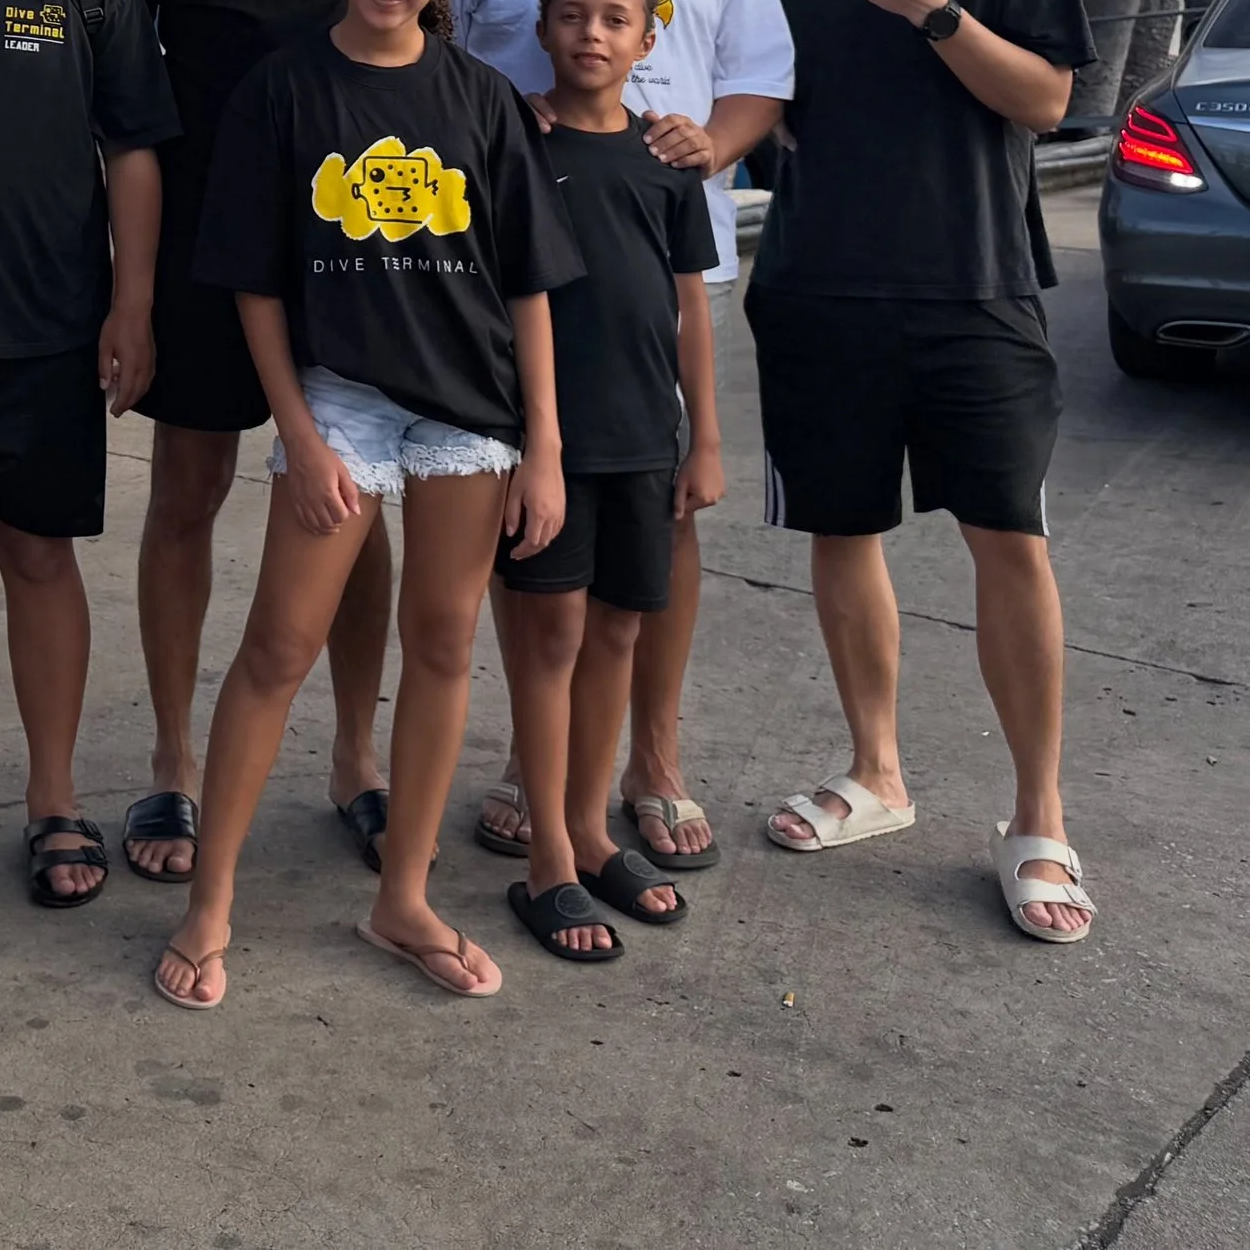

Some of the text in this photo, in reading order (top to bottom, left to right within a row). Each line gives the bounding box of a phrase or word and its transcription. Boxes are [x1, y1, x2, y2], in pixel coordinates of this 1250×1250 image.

[5, 7, 35, 20] Dive
[5, 21, 65, 38] Terminal
[4, 39, 40, 52] LEADER
[1195, 101, 1250, 112] C350
[313, 256, 478, 274] DIVE TERMINAL
